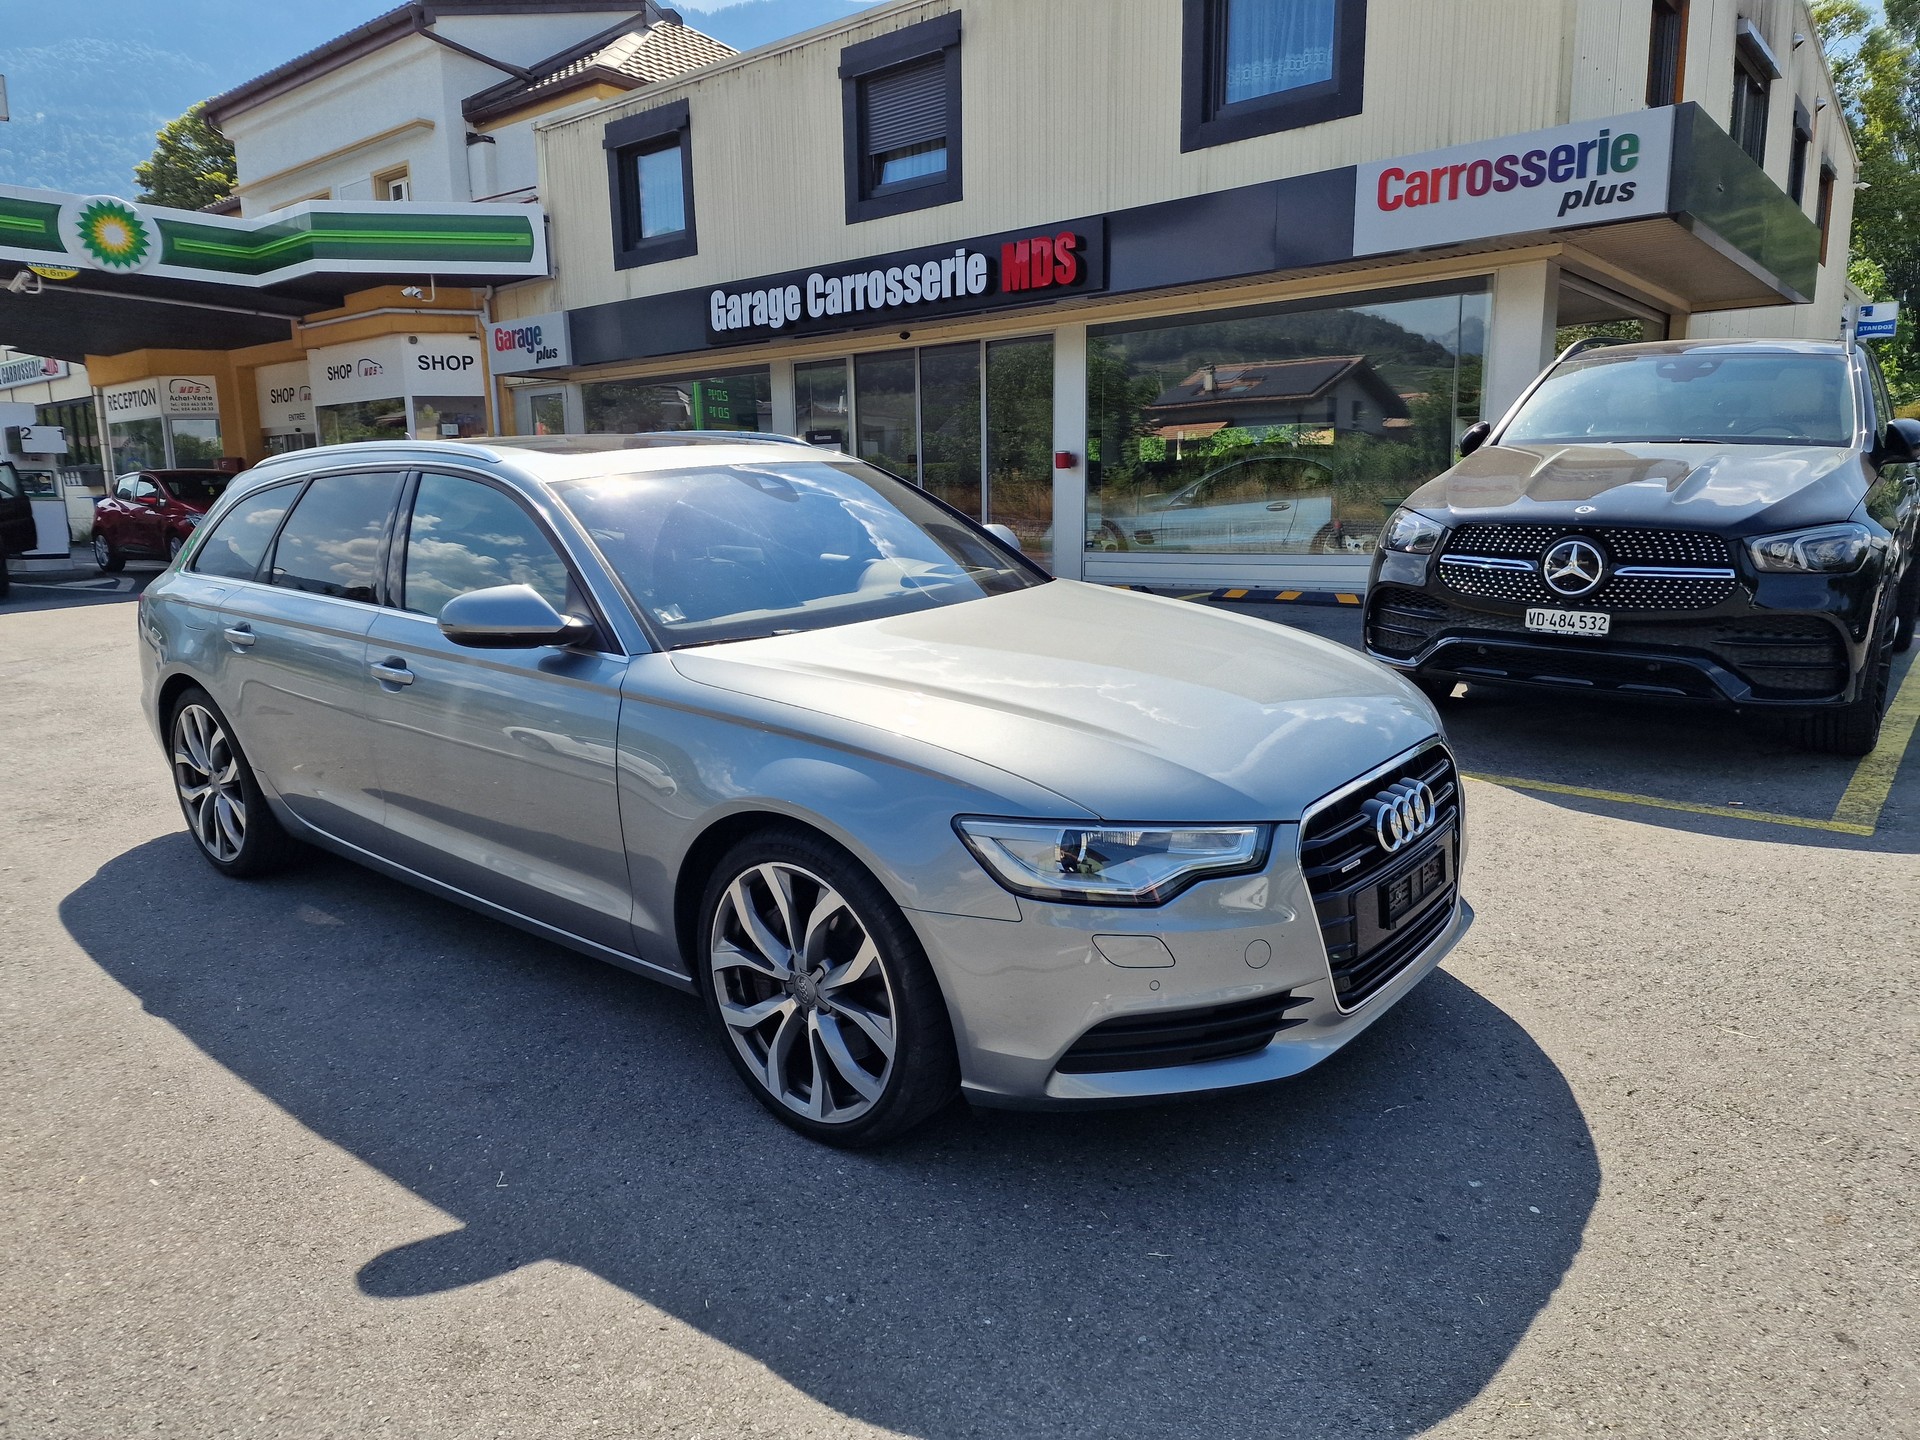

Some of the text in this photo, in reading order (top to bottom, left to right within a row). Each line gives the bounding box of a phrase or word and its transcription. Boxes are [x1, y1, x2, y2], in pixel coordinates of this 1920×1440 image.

[1377, 128, 1640, 212] Carrosserie
[1557, 180, 1637, 218] plus
[40, 268, 68, 277] 3.6m
[710, 231, 1077, 332] Garage Carrosserie MDS
[495, 325, 542, 354] Garage
[417, 354, 474, 371] SHOP
[536, 346, 558, 364] plus
[327, 363, 352, 381] SHOP
[107, 387, 157, 411] RECEPTION
[179, 386, 201, 394] MDS
[270, 387, 295, 404] SHOP
[20, 426, 33, 440] 2
